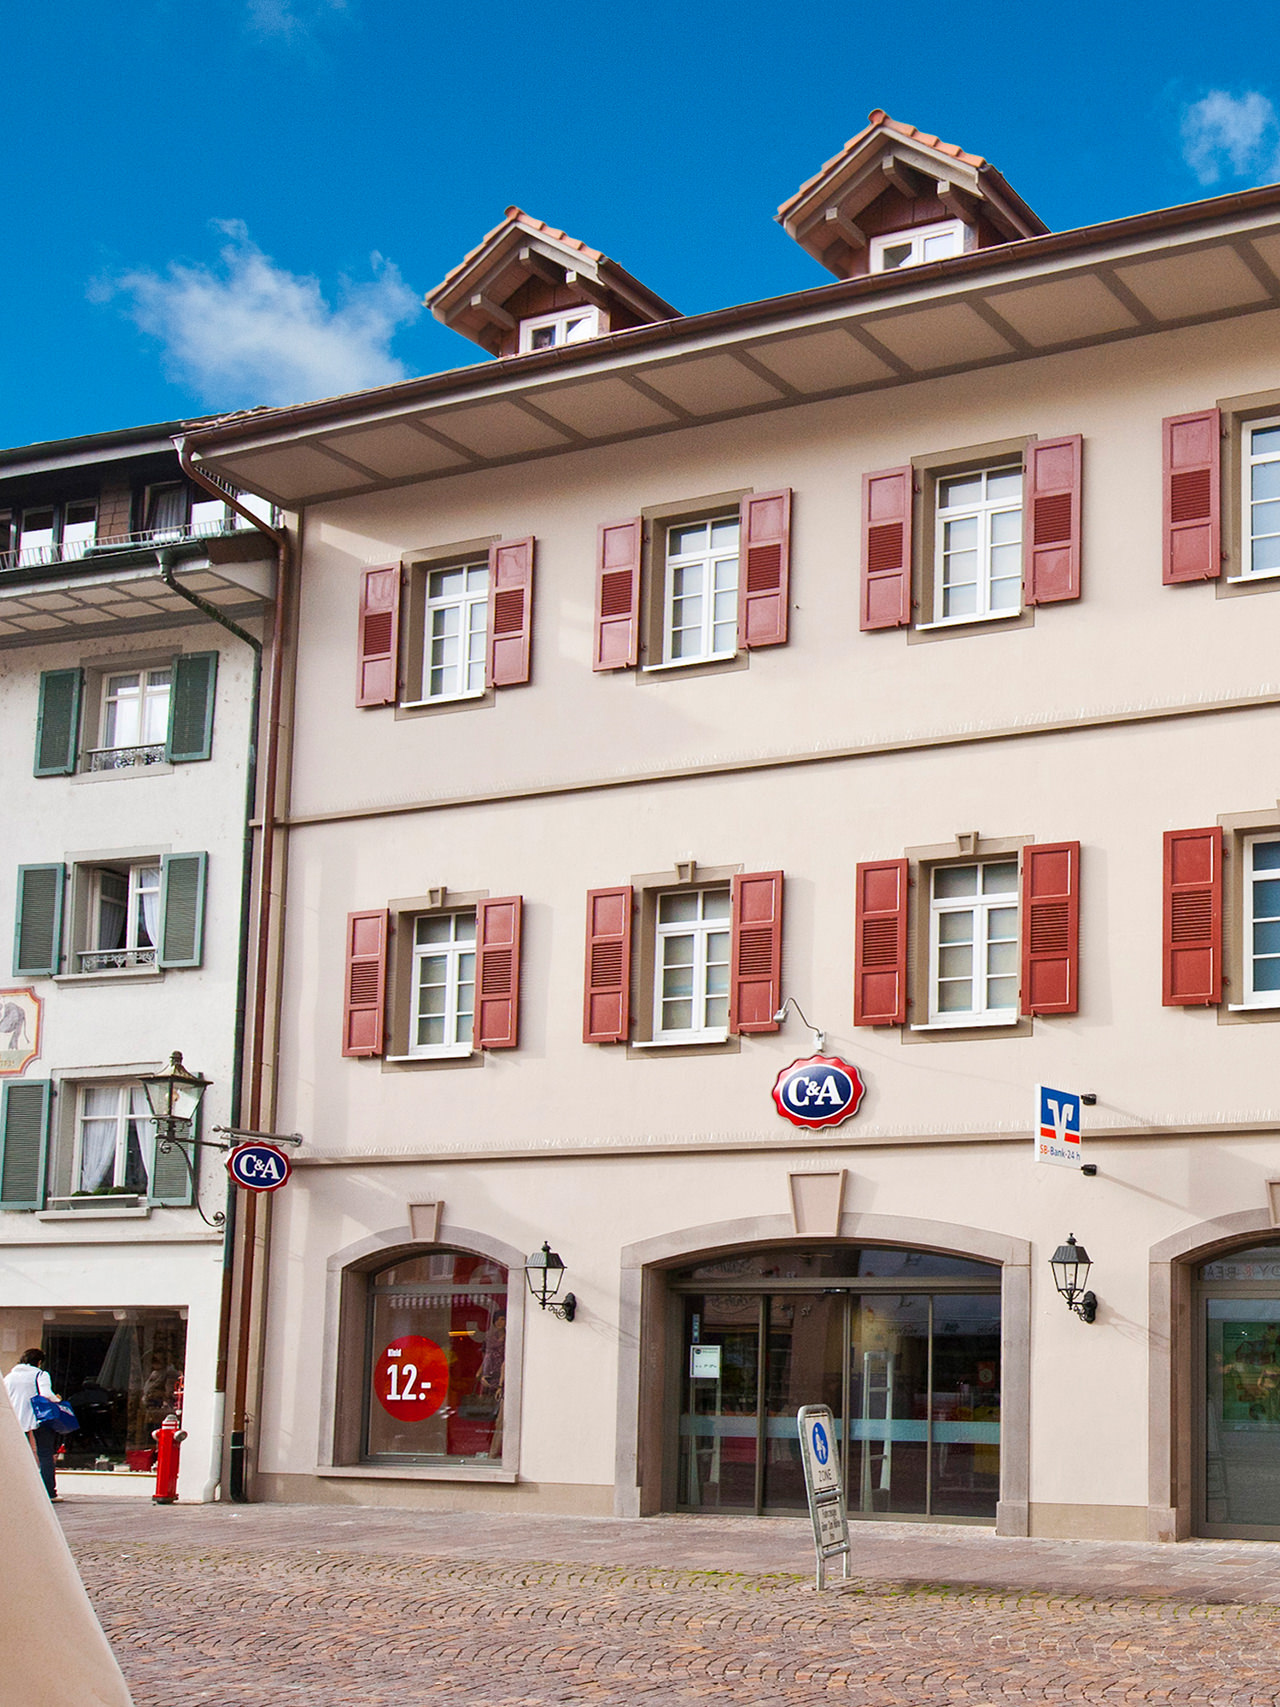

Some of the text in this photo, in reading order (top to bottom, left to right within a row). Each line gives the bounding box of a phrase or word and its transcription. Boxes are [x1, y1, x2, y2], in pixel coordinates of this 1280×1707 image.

[787, 1075, 844, 1106] C&A
[239, 1153, 281, 1180] C&A
[386, 1364, 432, 1401] 12.-
[818, 1468, 833, 1483] ZONE
